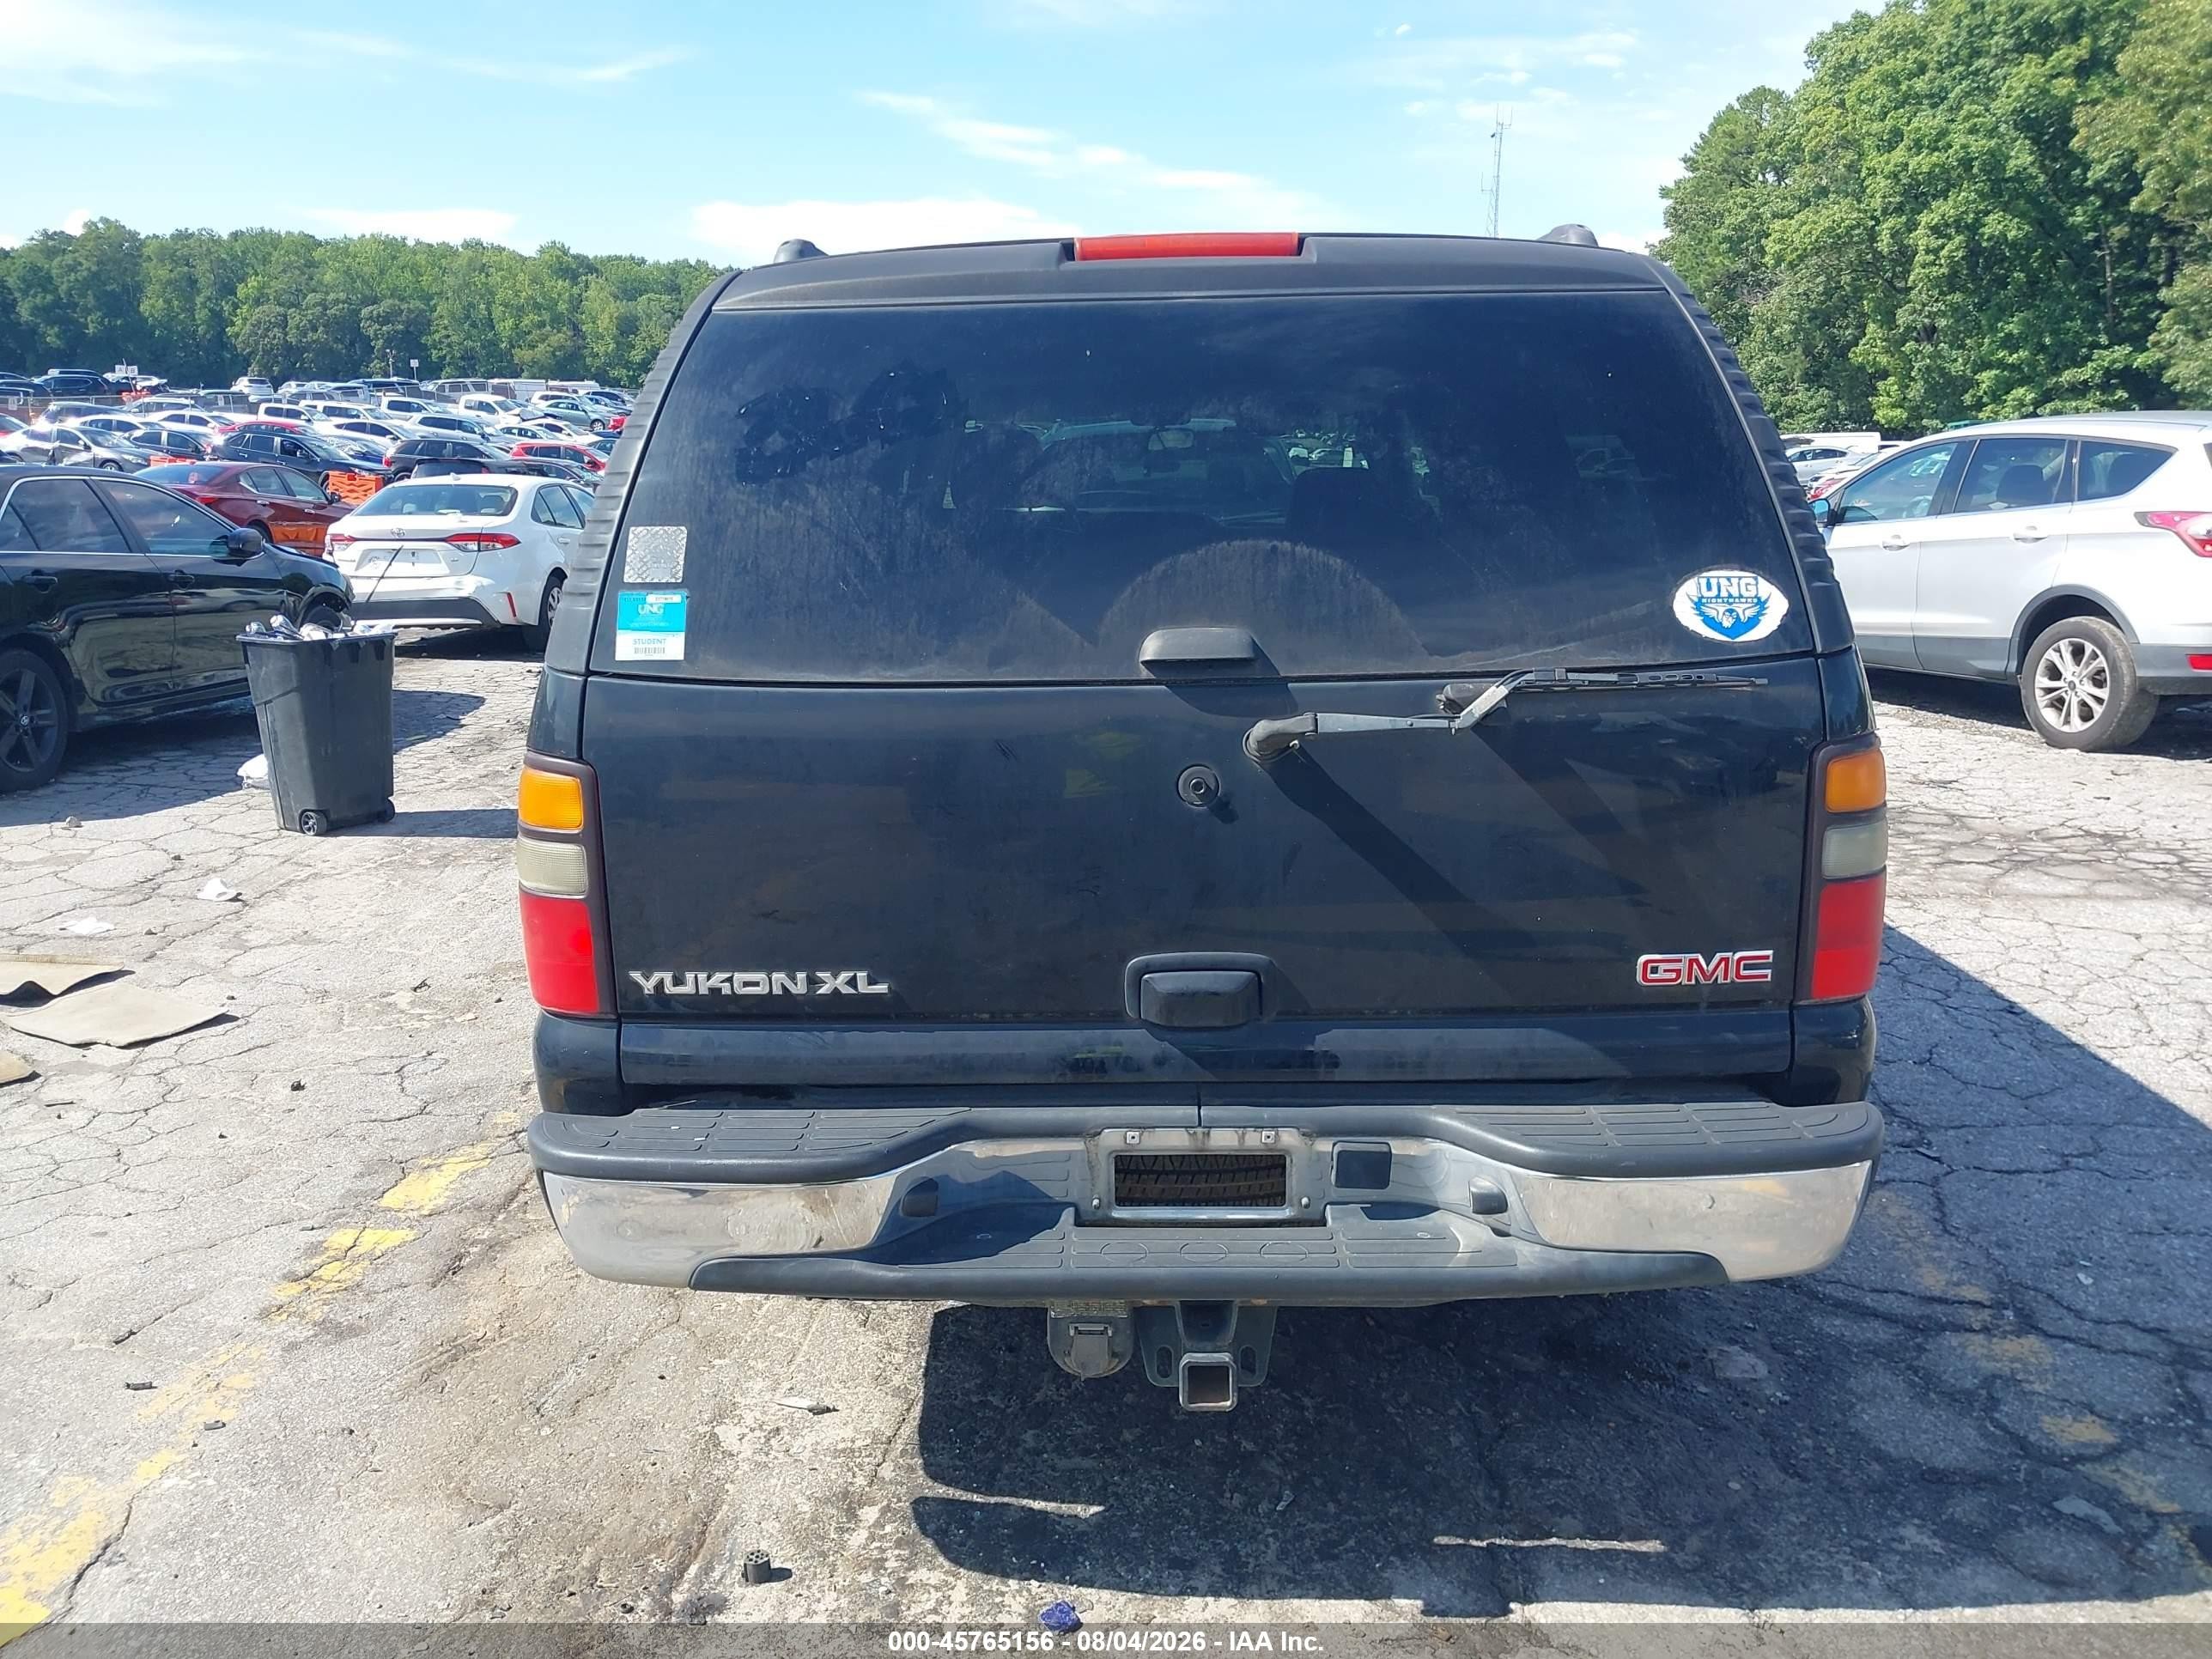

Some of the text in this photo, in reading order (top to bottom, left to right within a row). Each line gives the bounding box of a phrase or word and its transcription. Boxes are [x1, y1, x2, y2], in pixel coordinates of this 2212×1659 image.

[1698, 576, 1758, 598] UNG
[638, 604, 664, 615] UNG
[1636, 950, 1773, 987] GMC
[629, 970, 890, 995] YUKON XL
